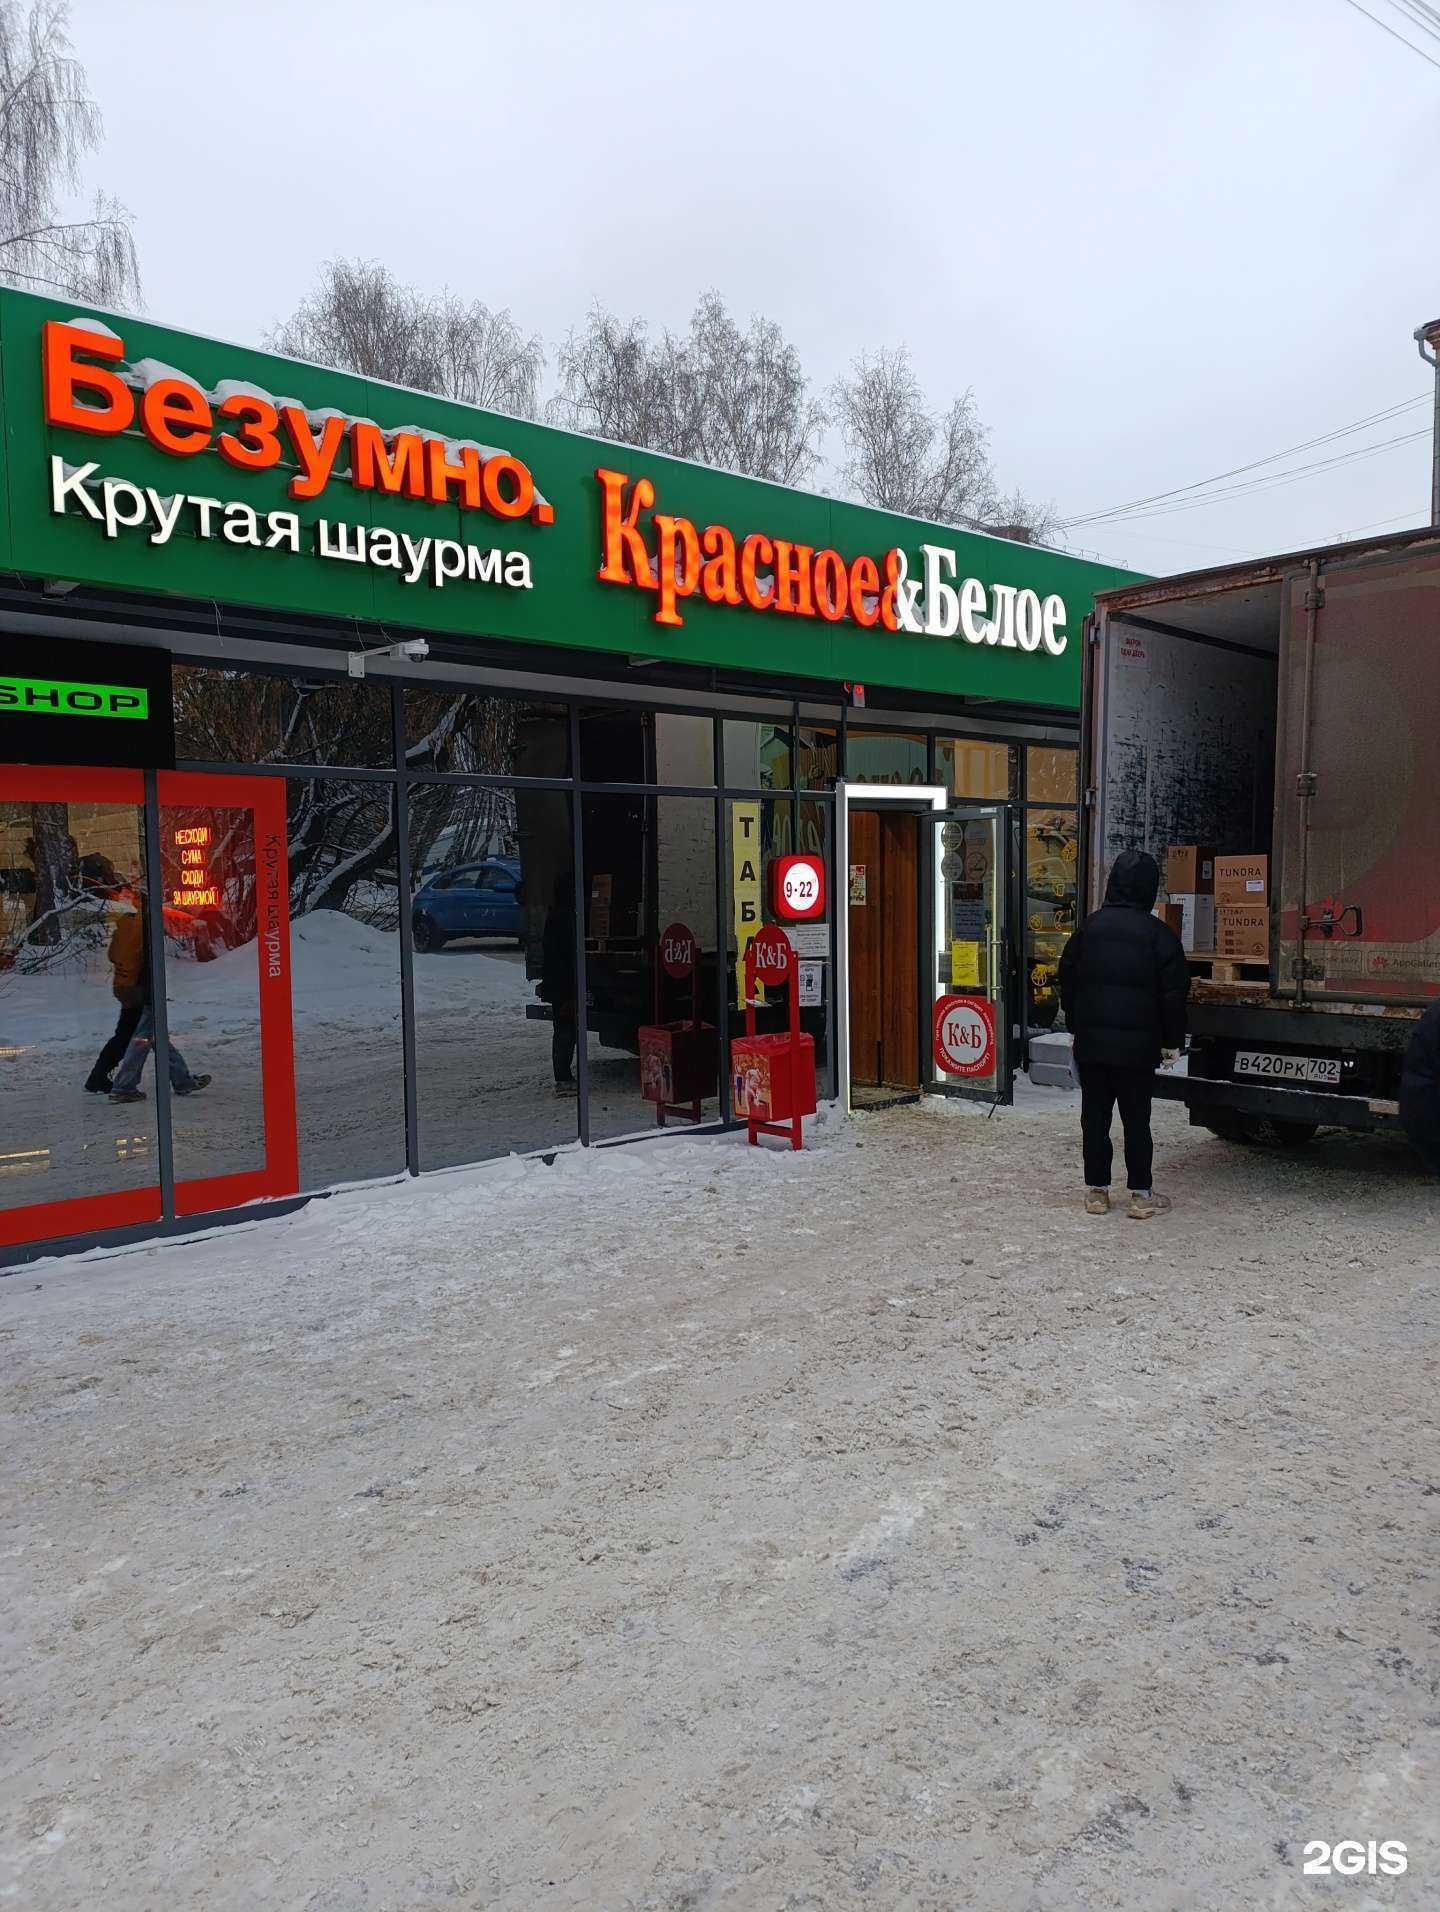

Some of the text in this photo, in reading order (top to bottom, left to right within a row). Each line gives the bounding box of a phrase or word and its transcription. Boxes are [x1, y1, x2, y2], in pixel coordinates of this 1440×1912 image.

[42, 318, 555, 526] Безумно.
[50, 454, 534, 590] Крутая шаурма
[0, 684, 141, 712] SHOP
[1220, 867, 1262, 878] TUNDRA
[1222, 917, 1265, 928] TUNDRA
[755, 940, 788, 970] К&Б
[947, 1022, 982, 1049] К&Б
